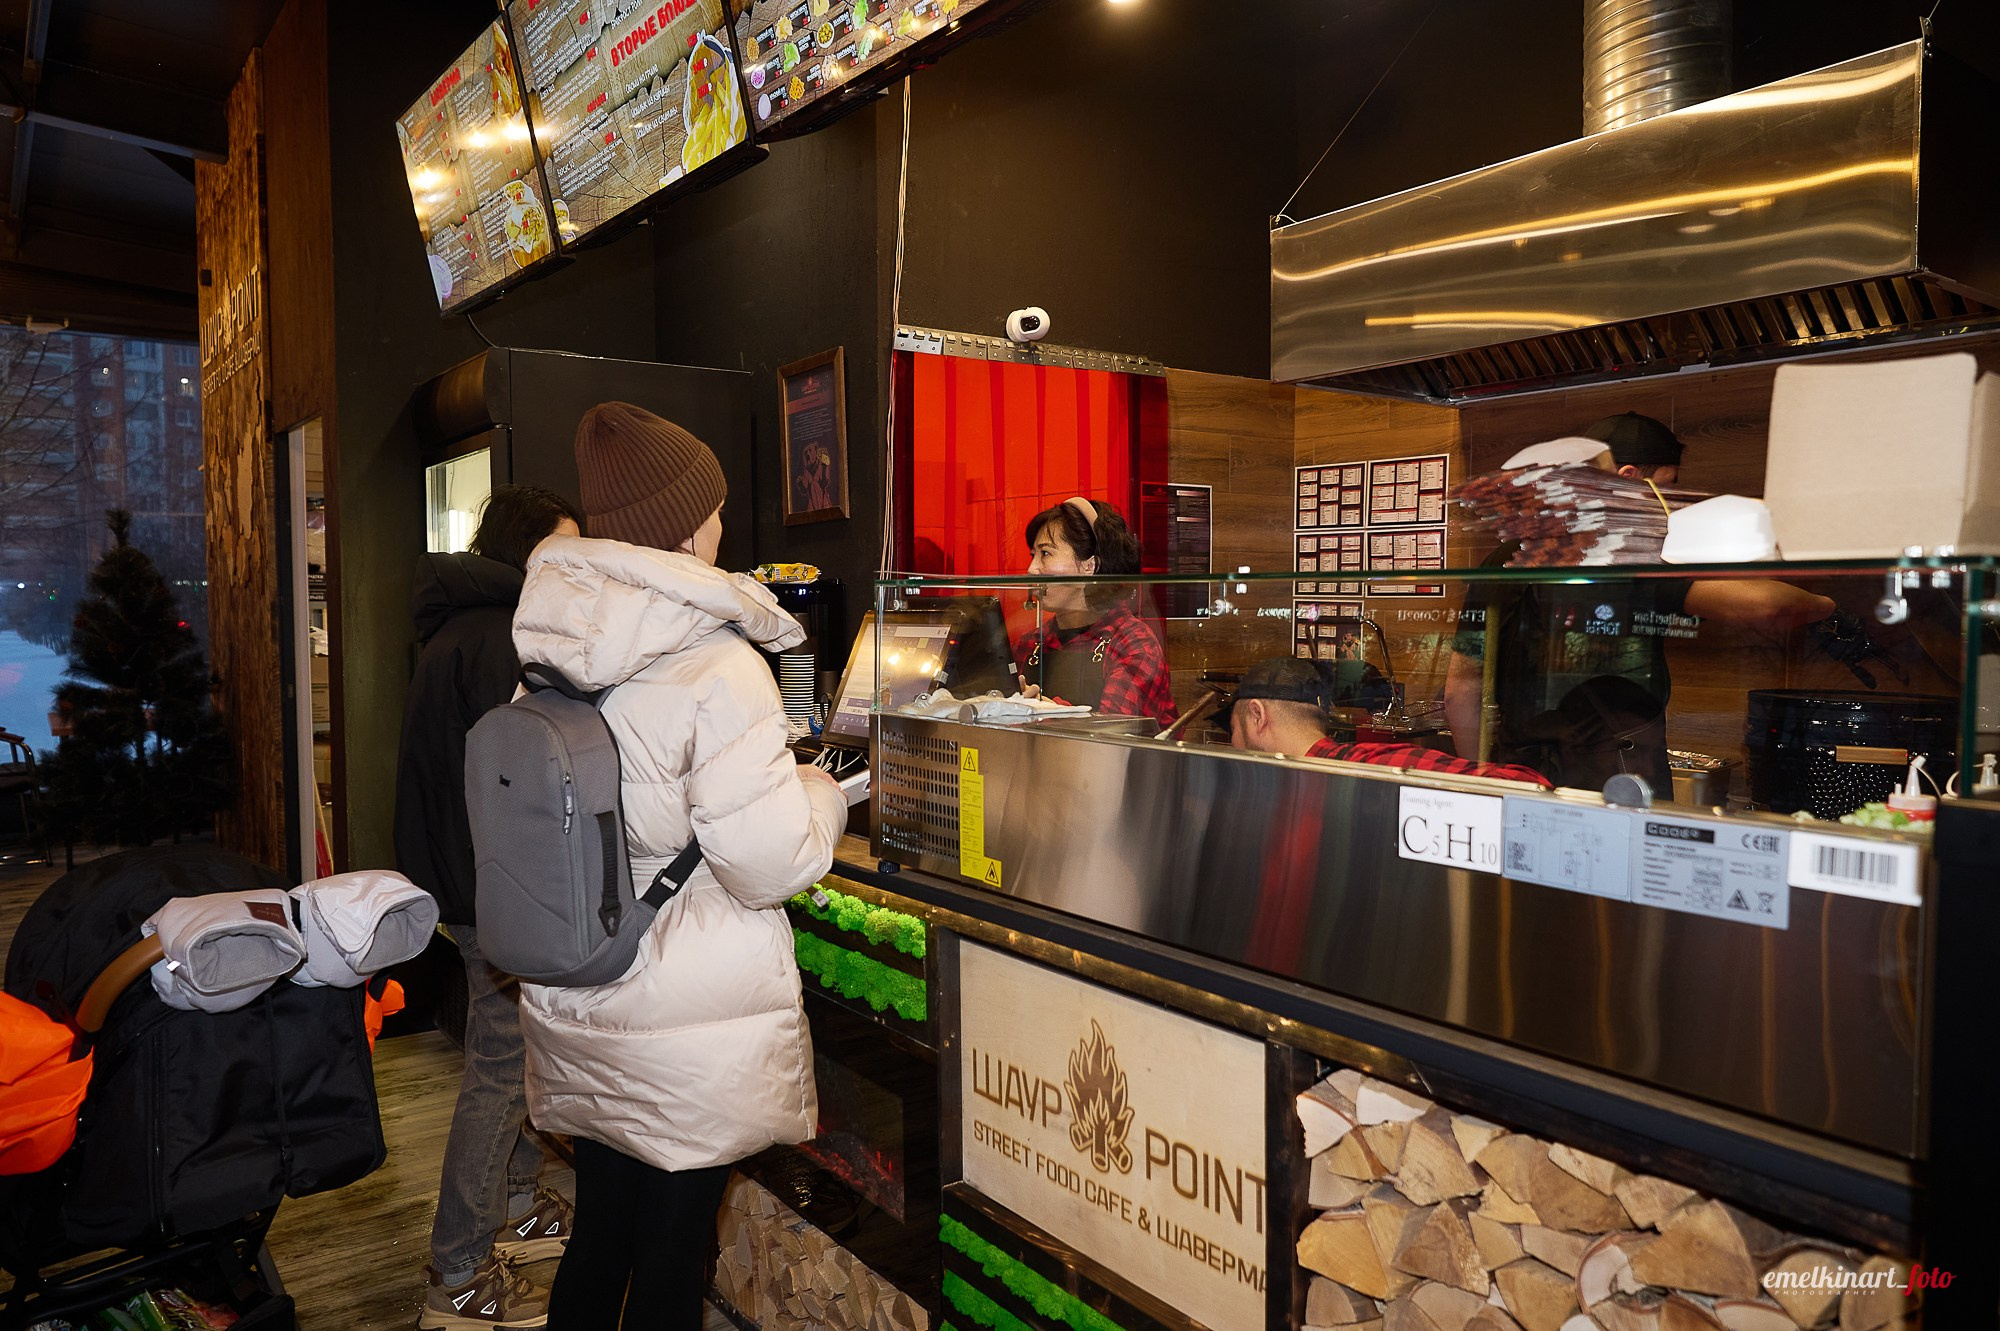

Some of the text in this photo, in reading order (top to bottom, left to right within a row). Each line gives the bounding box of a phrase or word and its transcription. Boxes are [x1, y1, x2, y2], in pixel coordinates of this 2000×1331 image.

[610, 15, 658, 67] ВТОРЫЕ
[231, 264, 259, 343] POINT
[972, 1048, 1266, 1235] ШАУР POINT
[973, 1119, 1032, 1166] STREET
[1035, 1153, 1081, 1195] FOOD
[1084, 1178, 1133, 1225] CAFE
[1137, 1206, 1152, 1235] &
